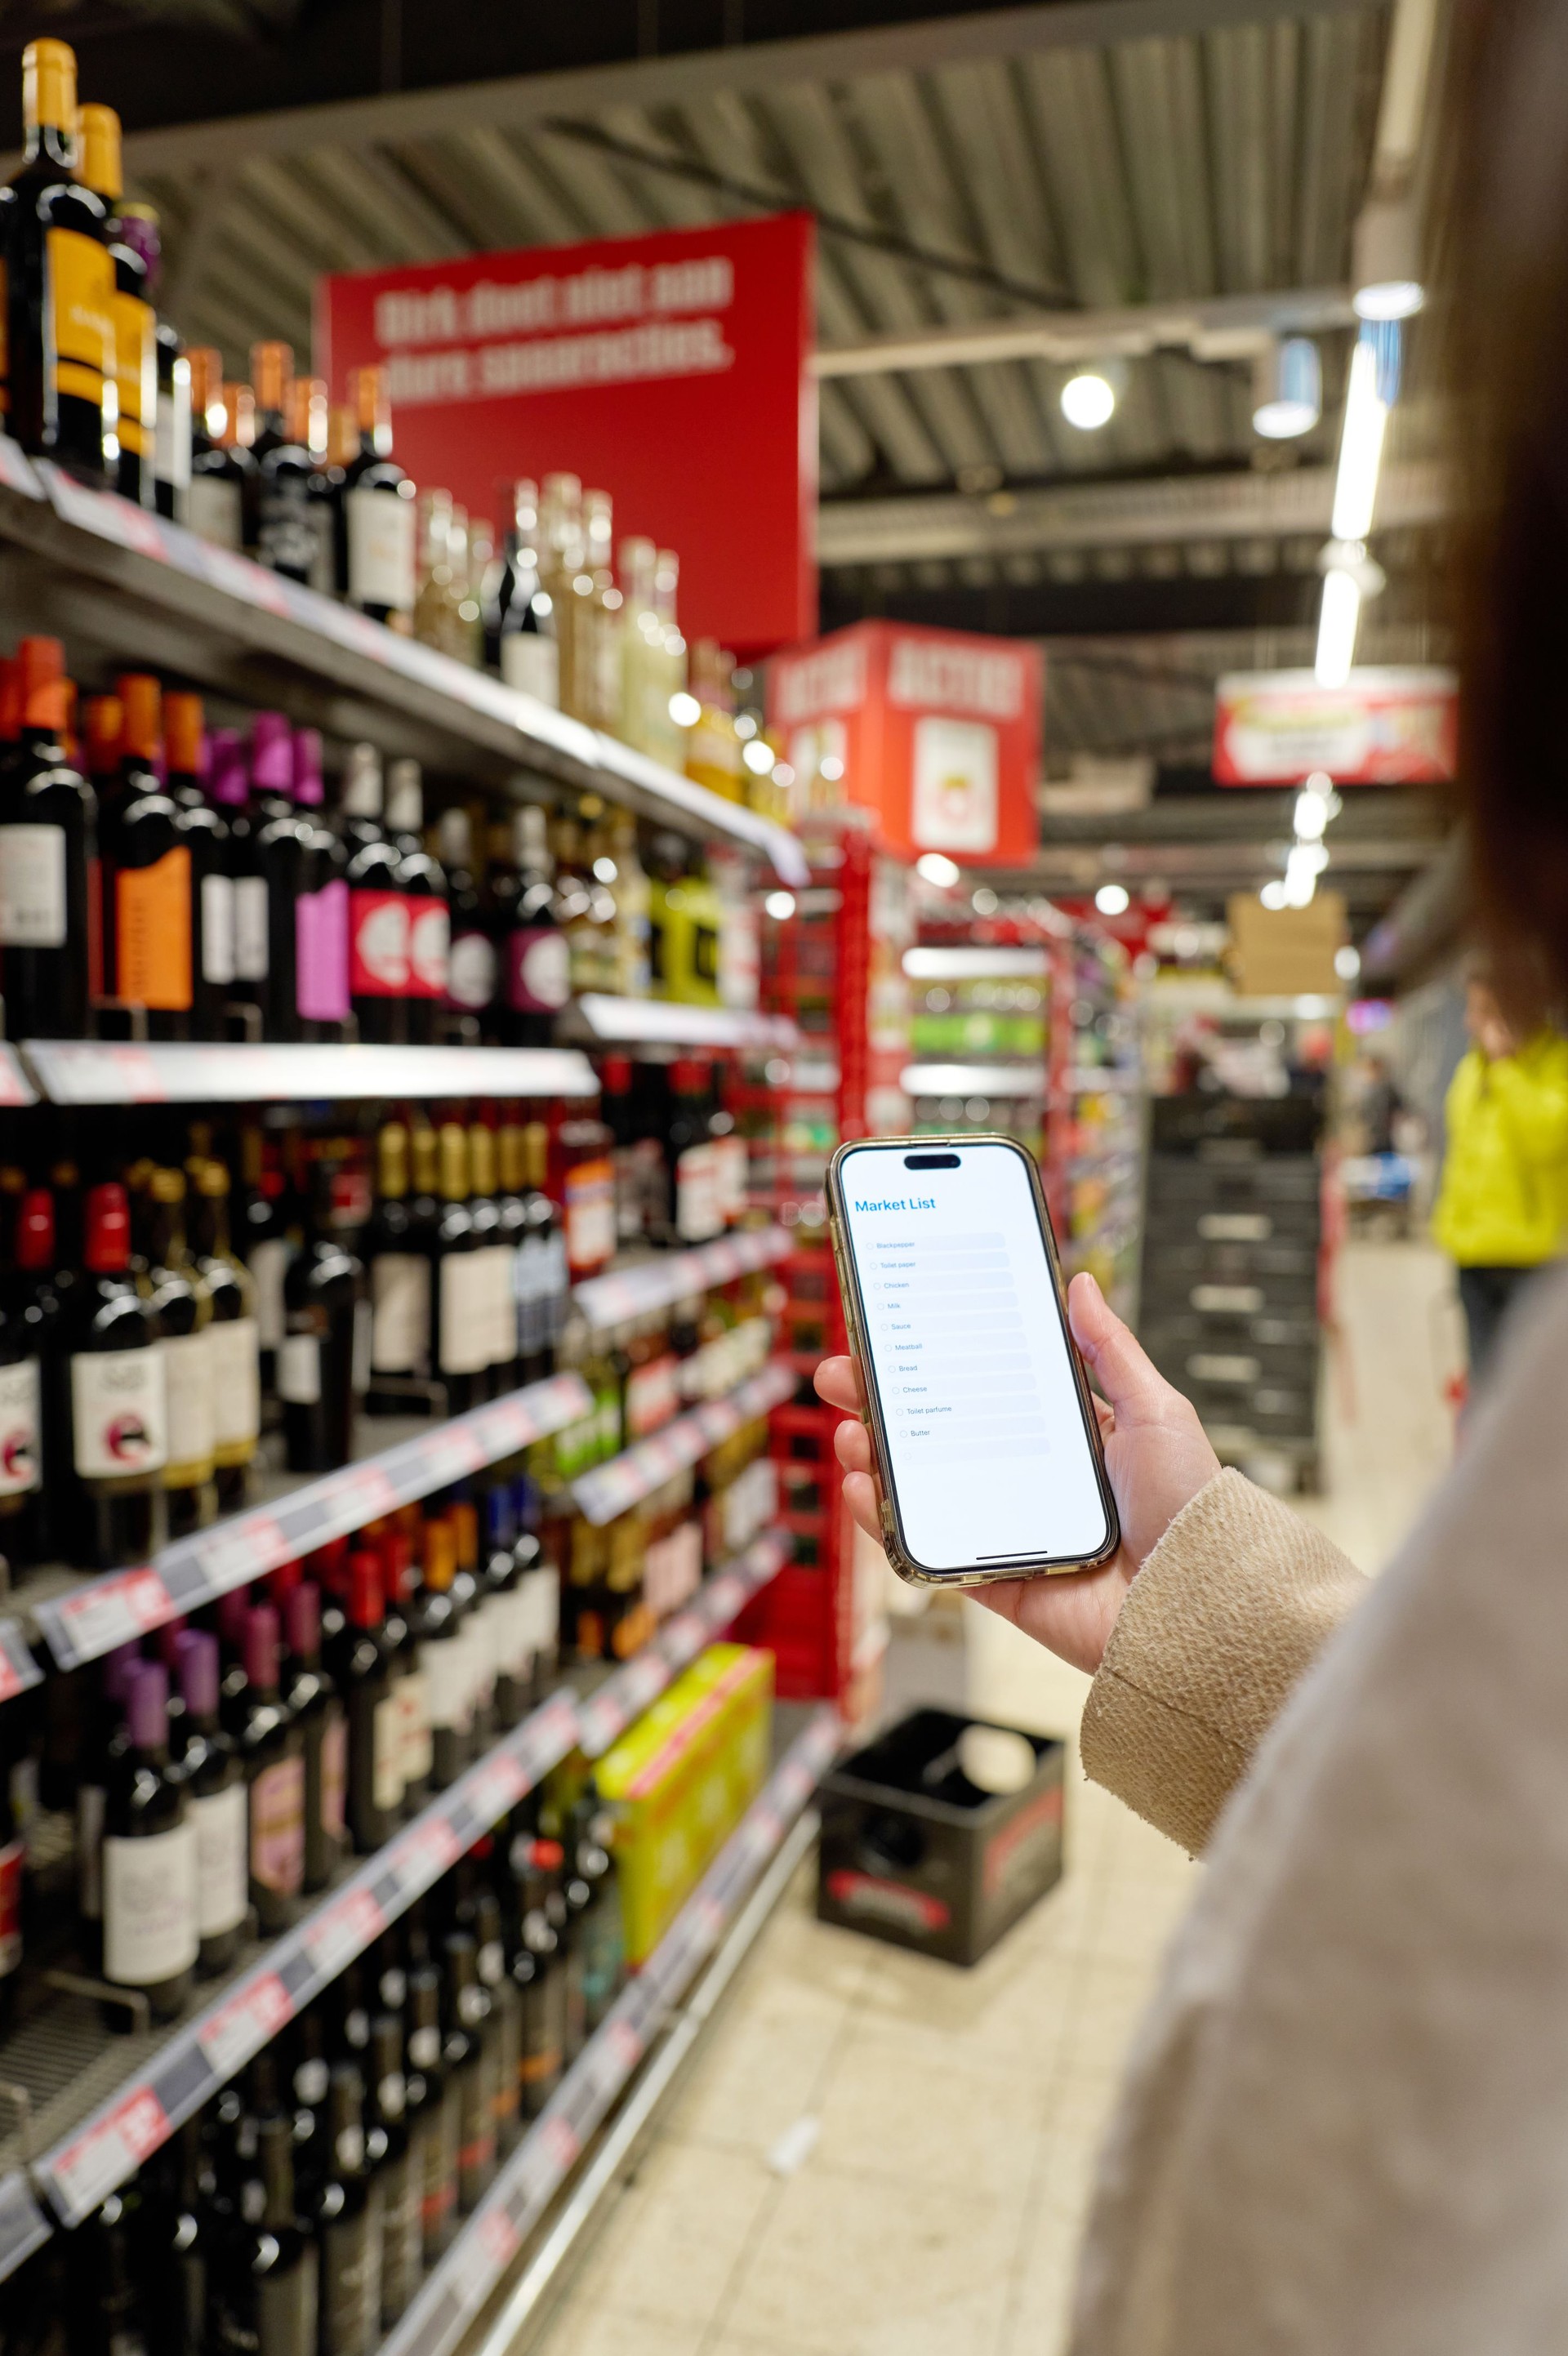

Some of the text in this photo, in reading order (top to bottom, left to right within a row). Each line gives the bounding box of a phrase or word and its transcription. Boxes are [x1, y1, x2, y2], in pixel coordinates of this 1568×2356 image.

[855, 1197, 937, 1212] Market List
[876, 1241, 915, 1249] Blackpepper
[895, 1343, 923, 1351] Meatball
[906, 1405, 952, 1415] Toilet parfume
[911, 1429, 931, 1437] Butter
